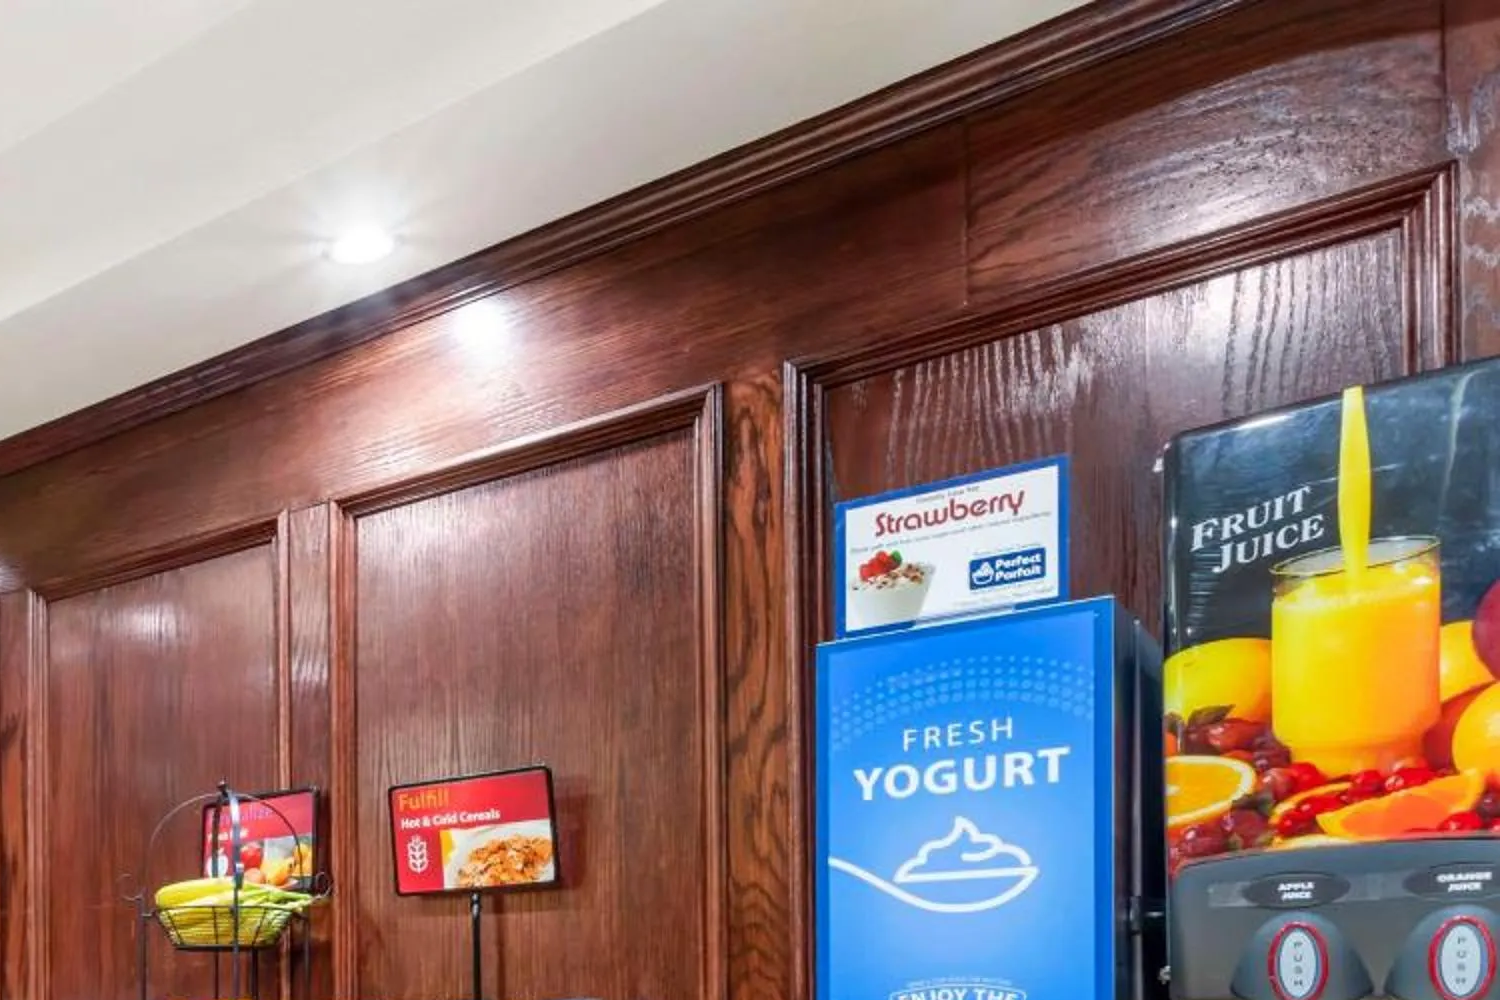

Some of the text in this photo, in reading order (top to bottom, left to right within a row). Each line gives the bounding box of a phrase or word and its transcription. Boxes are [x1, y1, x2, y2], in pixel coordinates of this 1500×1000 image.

[875, 491, 1025, 537] Strawberry
[1190, 486, 1311, 552] FRUIT
[1211, 513, 1325, 573] JUICE
[995, 552, 1042, 571] Perfect
[995, 565, 1042, 581] Parfait
[903, 716, 1014, 752] FRESH
[854, 746, 1071, 800] YOGURT
[399, 787, 449, 811] Fulfill
[401, 808, 501, 829] Hot & Cold Cereals
[1436, 871, 1493, 885] ORANGE
[1448, 881, 1483, 893] JUICE
